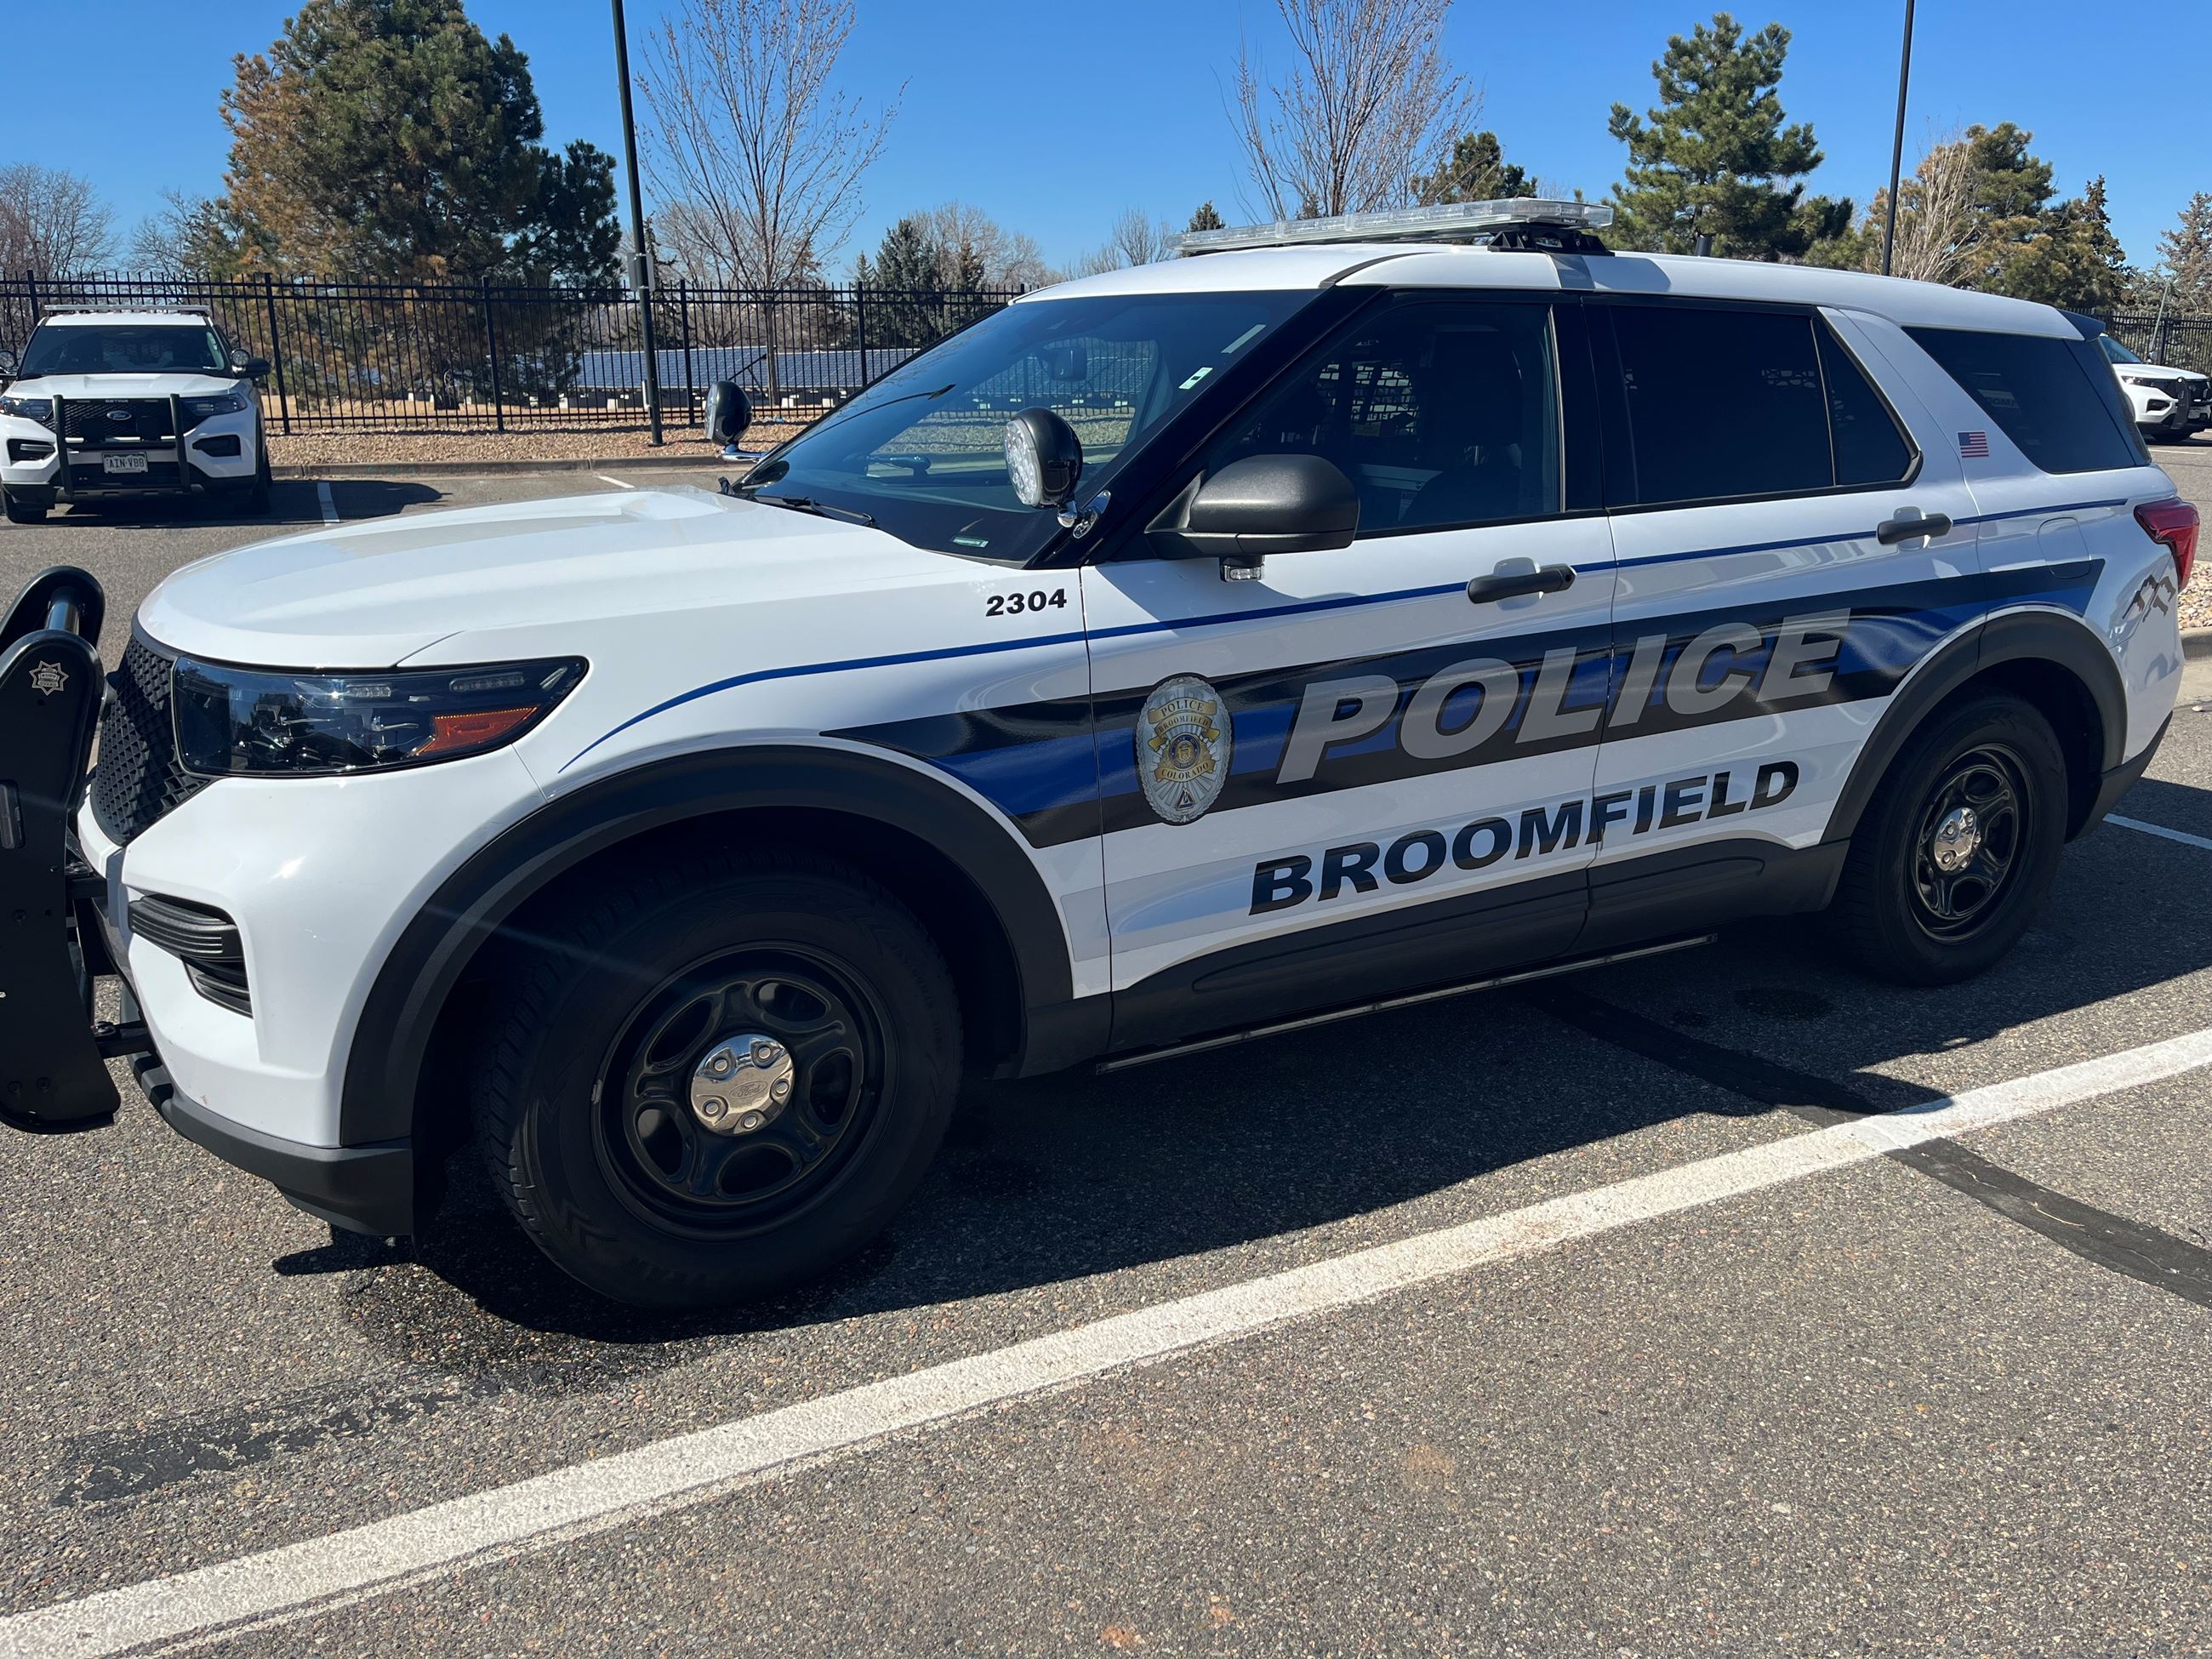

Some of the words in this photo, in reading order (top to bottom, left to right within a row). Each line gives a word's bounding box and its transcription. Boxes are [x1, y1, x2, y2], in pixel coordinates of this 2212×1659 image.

[985, 588, 1068, 617] 2304
[1276, 608, 1851, 785] POLICE
[1160, 700, 1205, 717] POLICE
[1157, 715, 1209, 733] BROOMFIELD
[1161, 761, 1209, 779] COLORADO
[1248, 761, 1799, 915] BROOMFIELD
[737, 1082, 761, 1097] Ford
